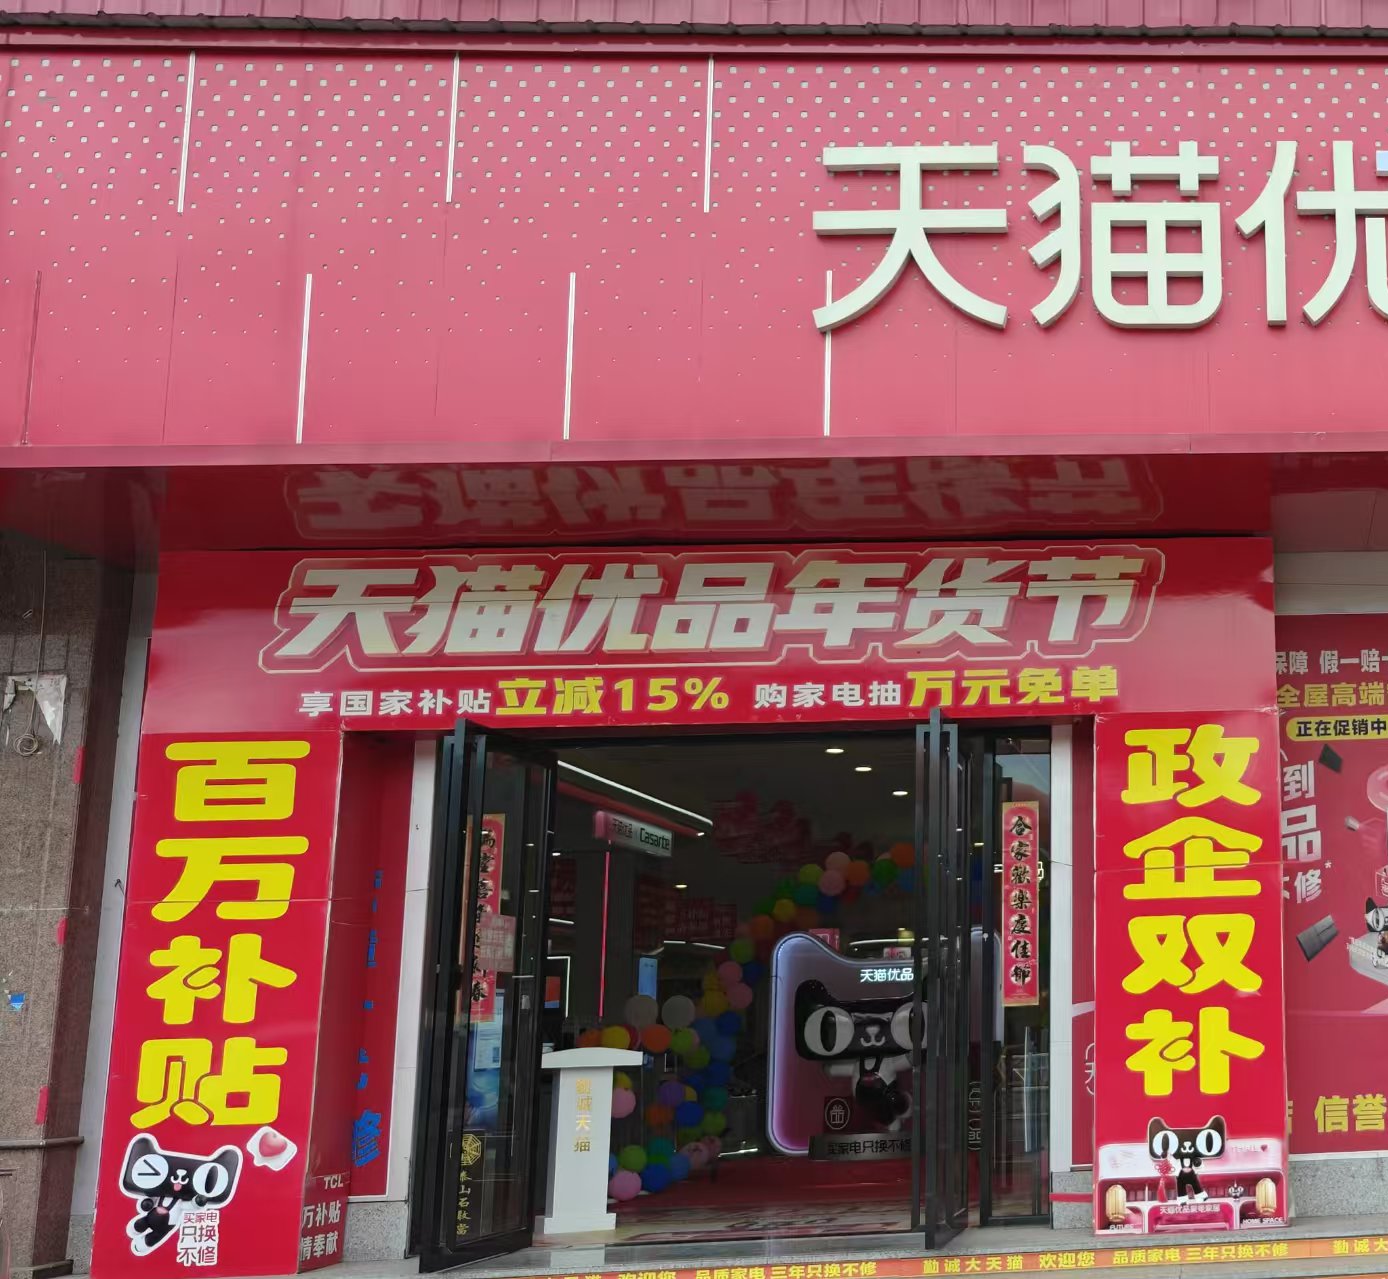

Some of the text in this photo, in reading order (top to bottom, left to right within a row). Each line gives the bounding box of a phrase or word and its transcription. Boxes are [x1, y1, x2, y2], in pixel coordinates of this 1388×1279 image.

[276, 553, 1145, 658] 天猫优品年货节
[1296, 718, 1388, 737] 正在促销中
[639, 827, 670, 851] Casarte
[1121, 724, 1265, 1097] 政企双补
[130, 740, 311, 1130] 百万补贴
[860, 967, 914, 982] 天猫优品
[323, 1175, 344, 1189] TCL
[184, 1212, 217, 1223] 买家电
[180, 1225, 217, 1243] 只换
[180, 1246, 217, 1264] 不修
[1039, 1251, 1095, 1269] 欢迎您
[1112, 1248, 1181, 1264] 品质家电
[1186, 1243, 1289, 1261] 三年只换不修
[770, 1261, 877, 1279] 三年只换不修
